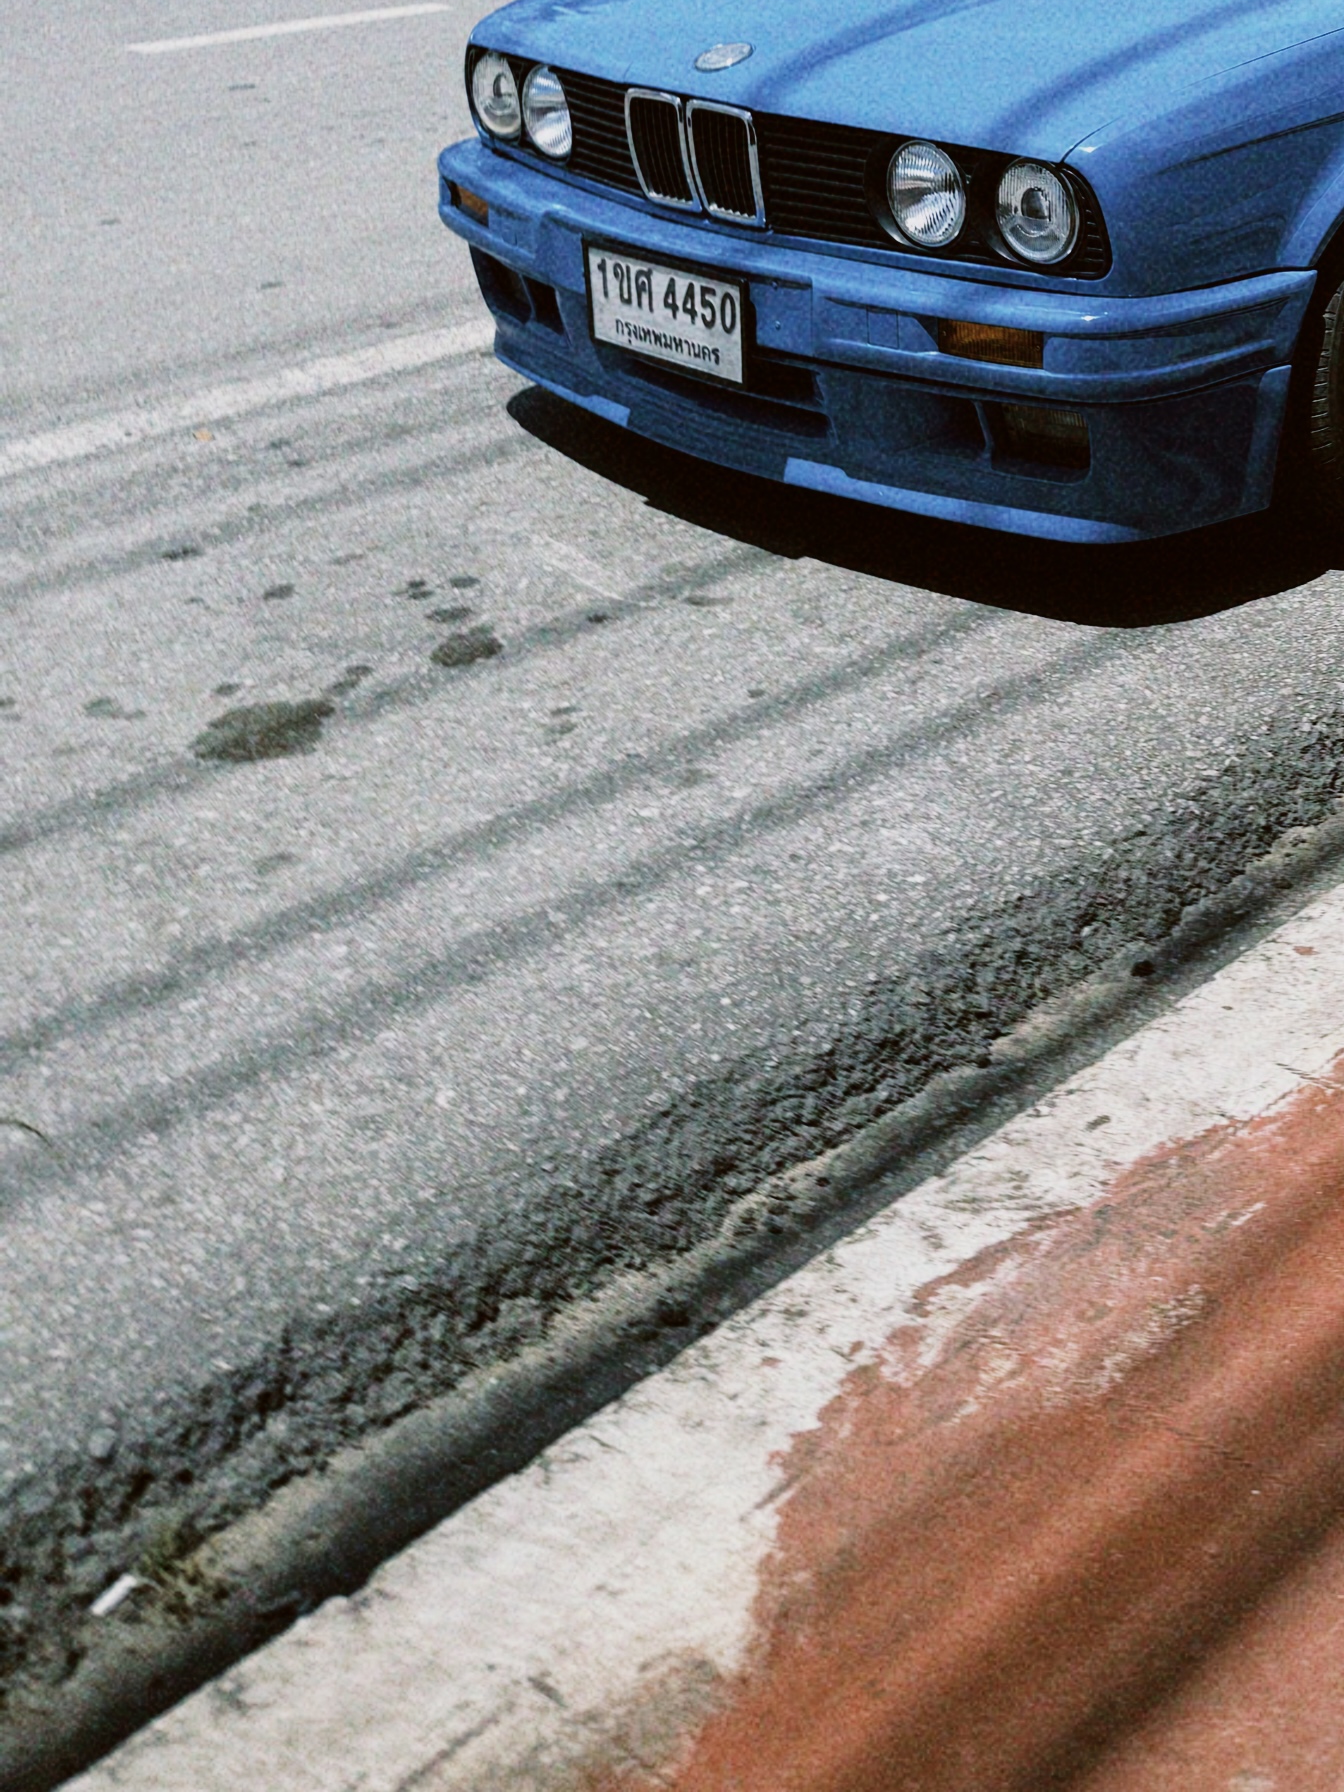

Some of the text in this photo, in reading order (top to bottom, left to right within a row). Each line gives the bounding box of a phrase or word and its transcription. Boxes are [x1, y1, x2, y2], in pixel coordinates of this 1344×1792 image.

[597, 258, 737, 334] 1ขศ 4450
[615, 317, 721, 366] กรุงเทพมหานคร
